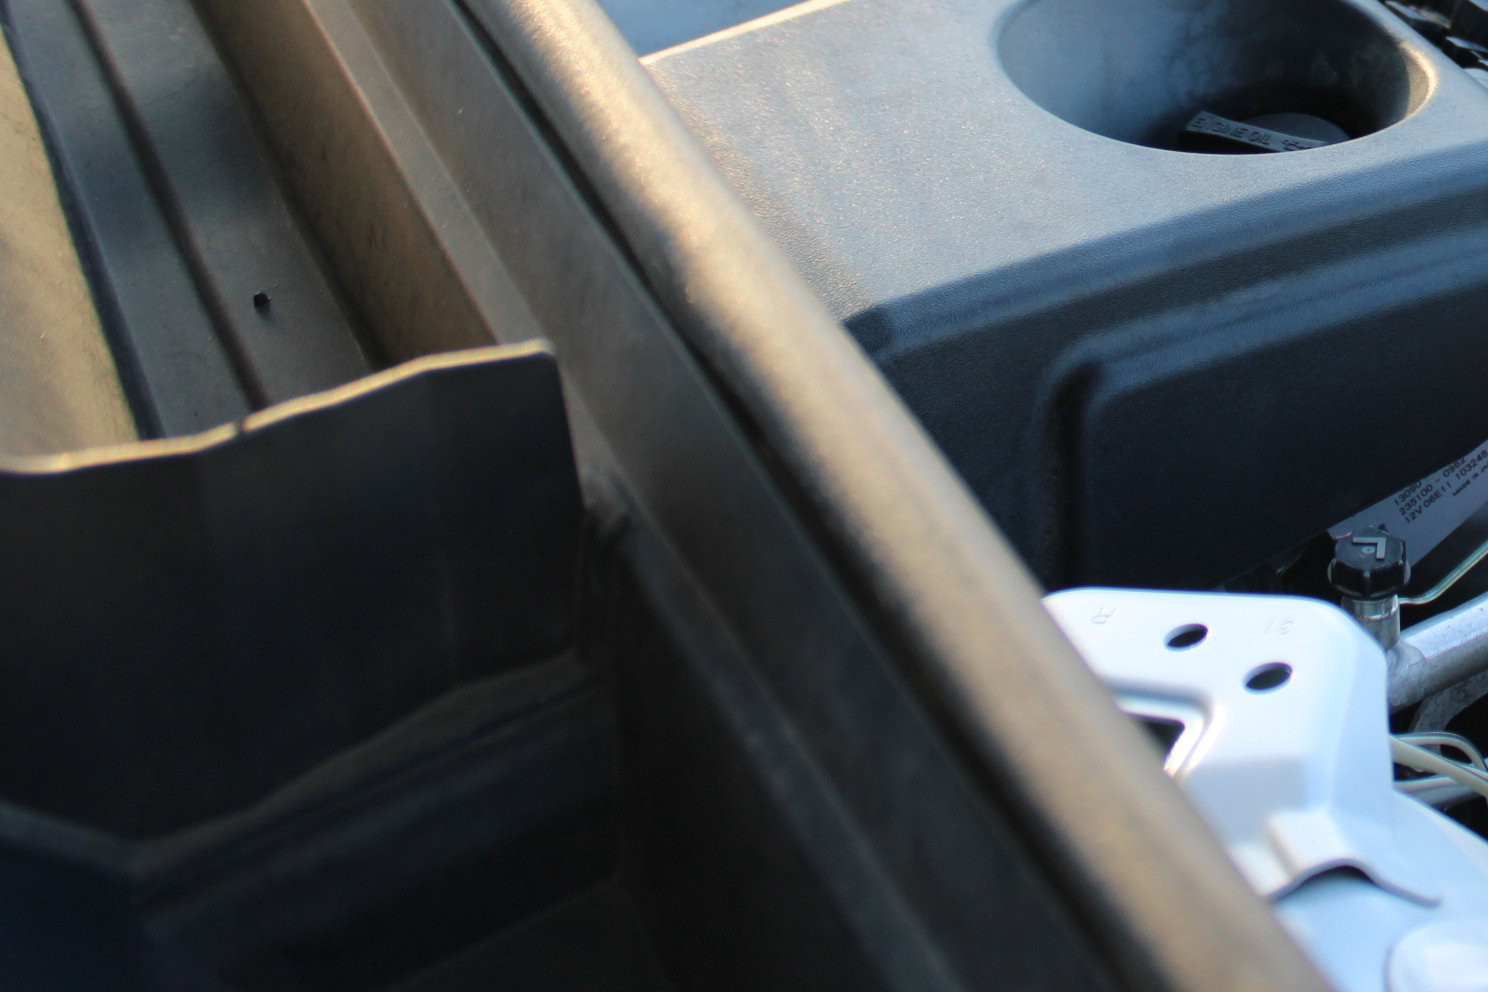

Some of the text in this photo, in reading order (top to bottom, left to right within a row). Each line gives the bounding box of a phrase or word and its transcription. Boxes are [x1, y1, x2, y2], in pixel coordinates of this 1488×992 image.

[1191, 117, 1249, 139] ENGINE
[1247, 130, 1272, 146] OIL
[1405, 505, 1422, 524] 12V
